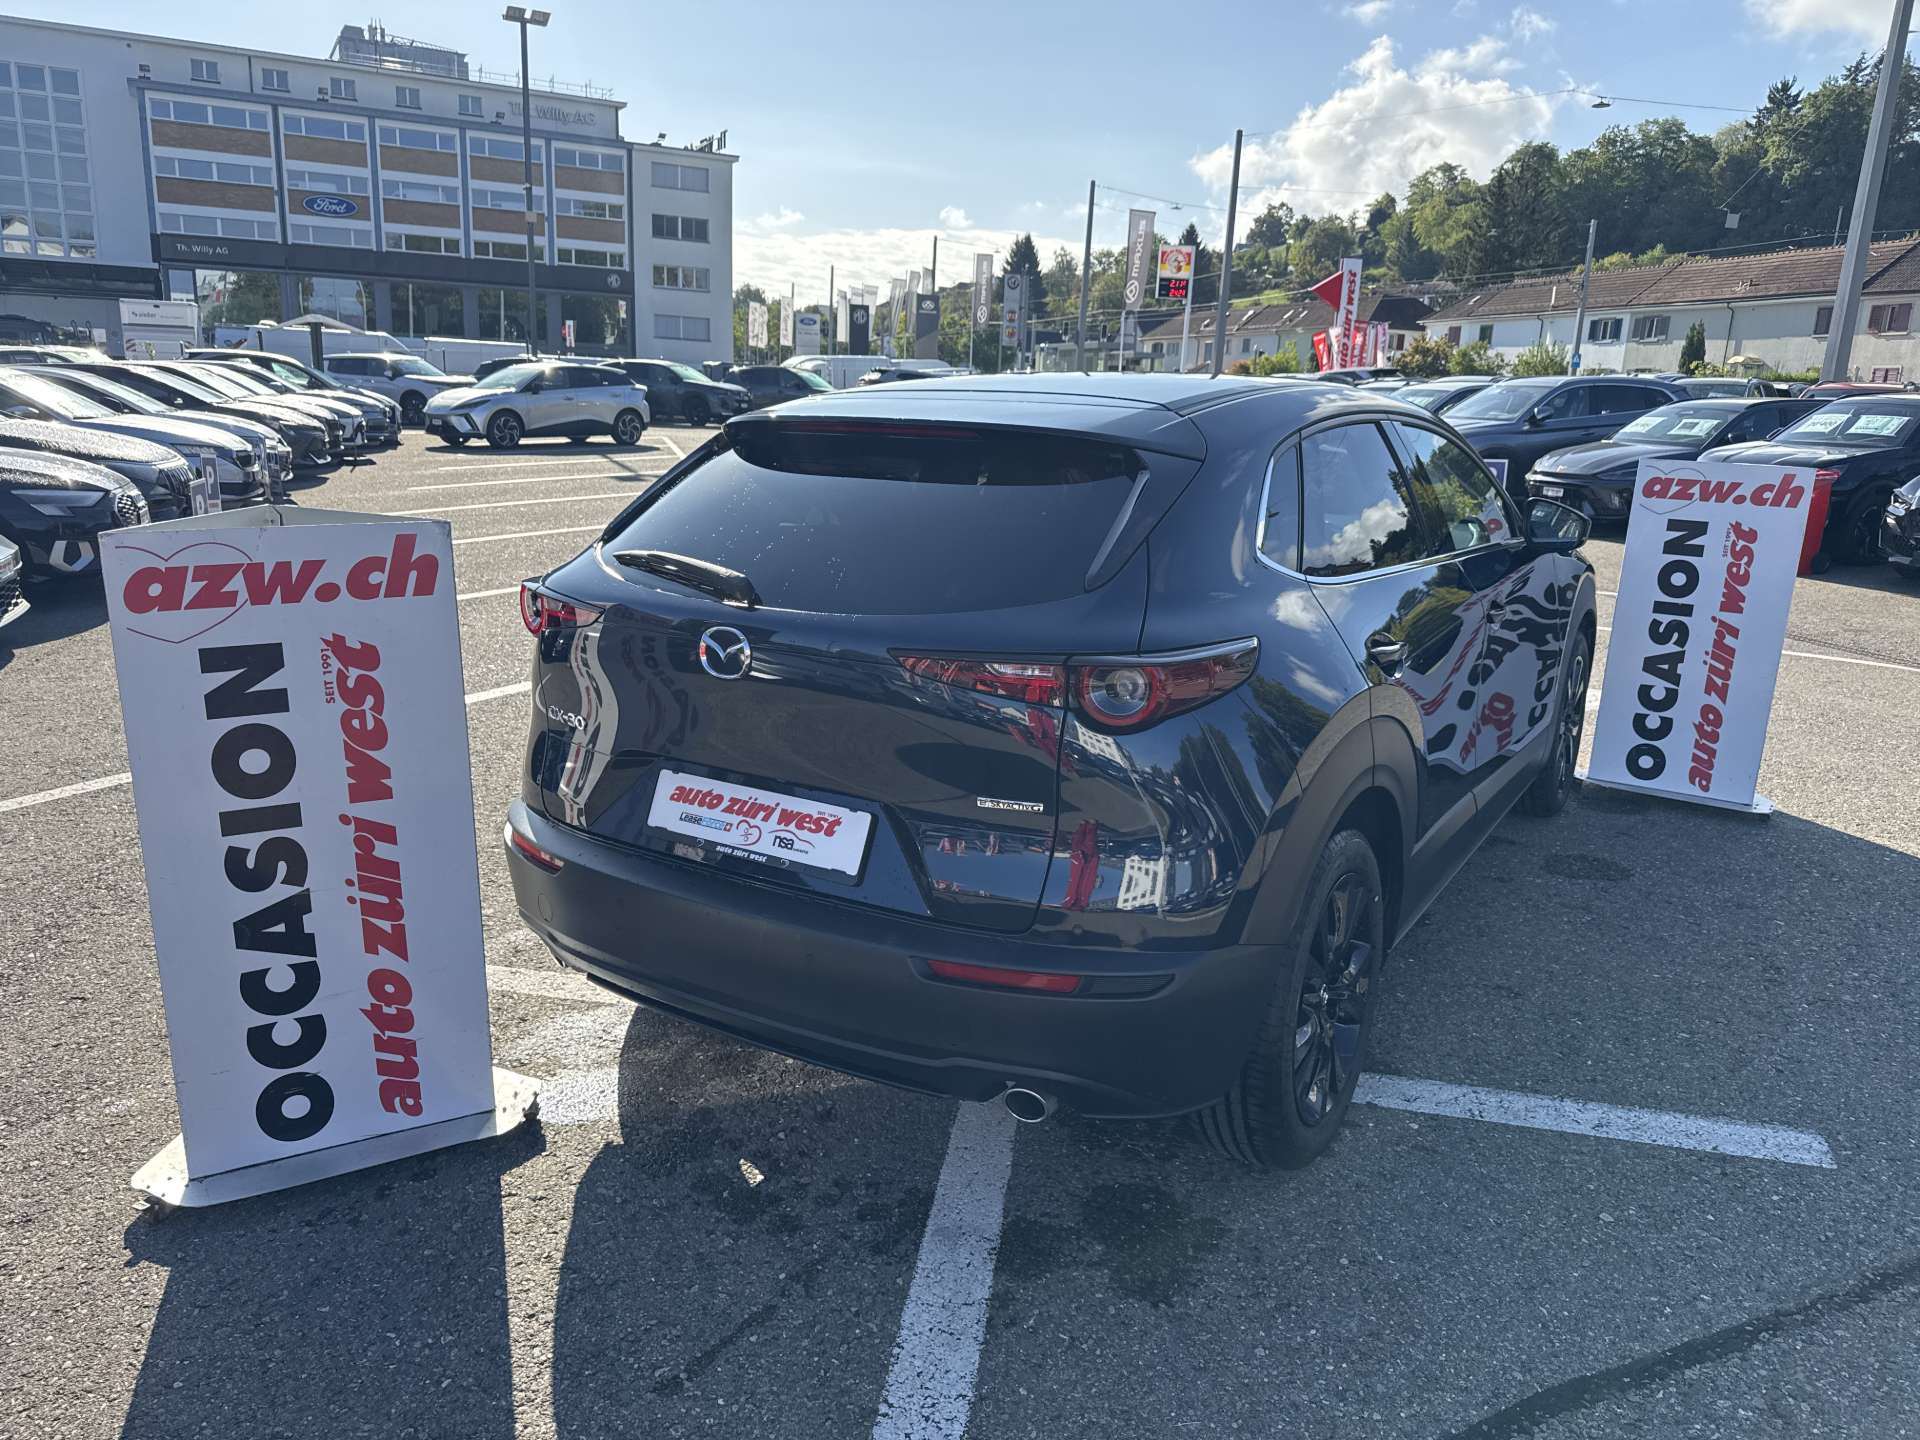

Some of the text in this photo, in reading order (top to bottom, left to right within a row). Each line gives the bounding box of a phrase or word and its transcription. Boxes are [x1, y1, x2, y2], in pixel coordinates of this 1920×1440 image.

[535, 104, 570, 126] Willy
[313, 196, 347, 213] Ford
[192, 244, 213, 256] Willy
[215, 246, 229, 255] AG
[1642, 473, 1805, 509] azw.ch
[123, 533, 439, 614] azw.ch
[1625, 518, 1709, 781] OCCASION
[1688, 520, 1758, 793] auto züri west
[320, 648, 336, 704] SEIT 1991
[548, 705, 585, 730] CX-30
[669, 785, 843, 838] auto züri west
[715, 845, 733, 854] auto
[749, 853, 768, 863] west
[772, 834, 794, 851] nsa
[198, 642, 335, 1142] OCCASION
[320, 632, 424, 1118] auto züri west
